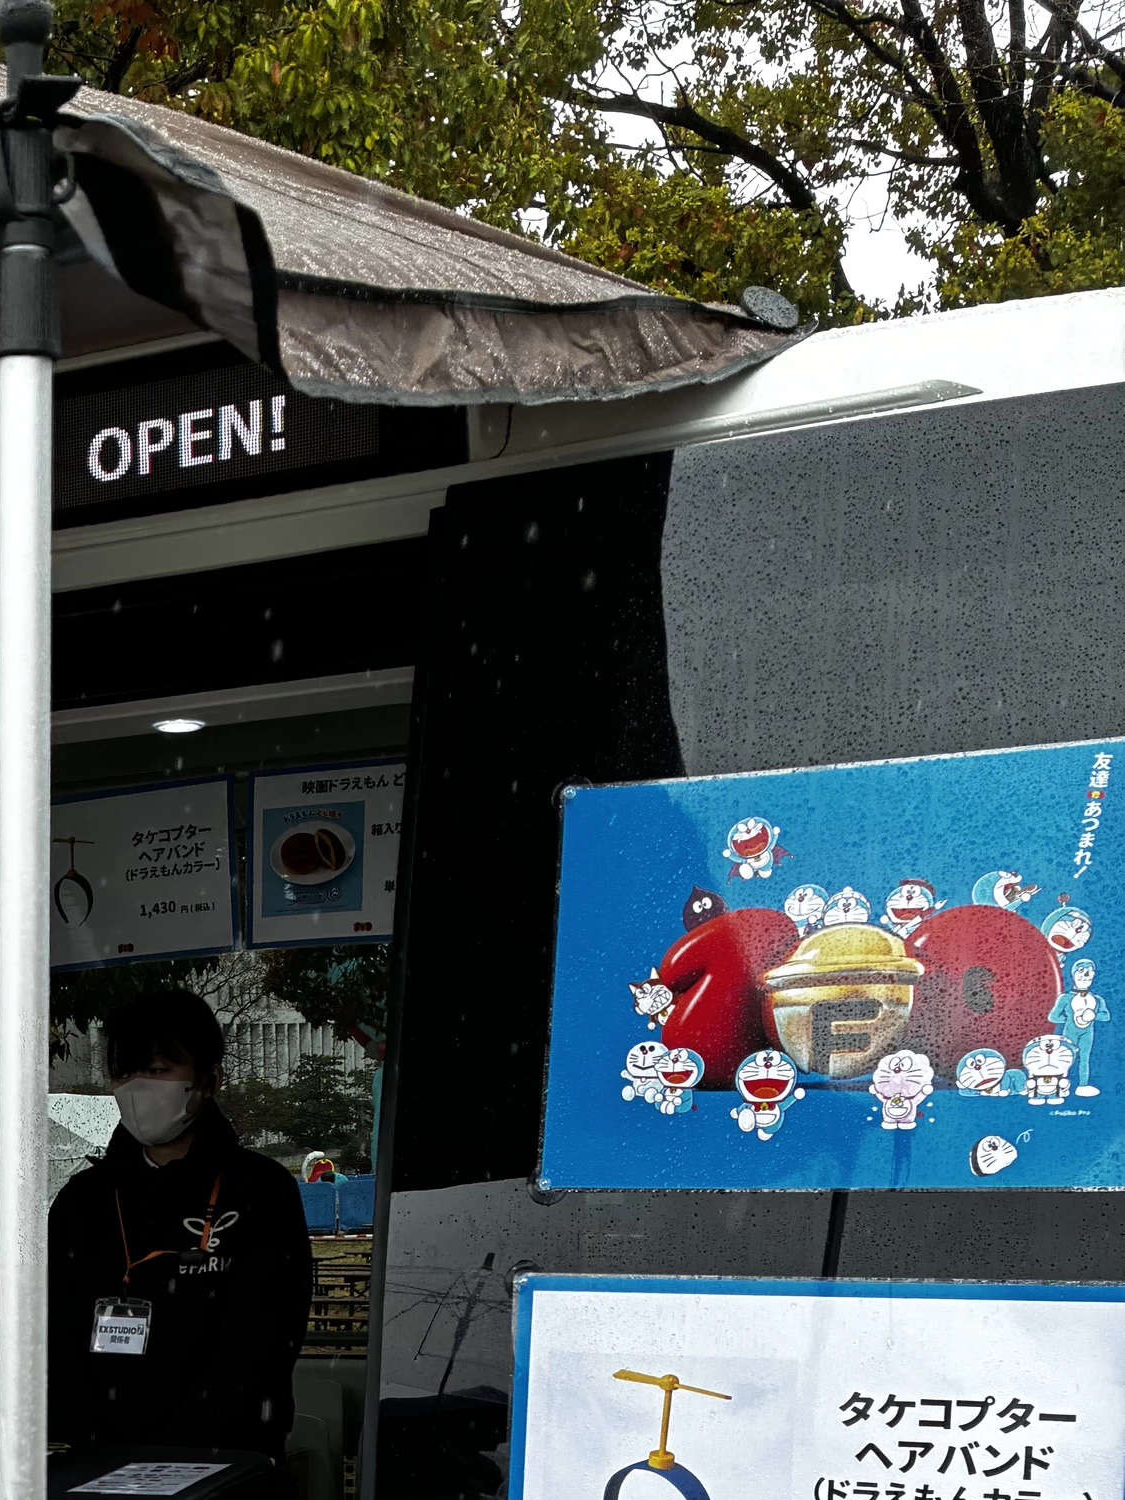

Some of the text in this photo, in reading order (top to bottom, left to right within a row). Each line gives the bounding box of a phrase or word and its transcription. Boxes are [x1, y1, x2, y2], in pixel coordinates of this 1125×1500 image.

[87, 395, 287, 482] OPEN!
[131, 823, 212, 848] タケコプター
[138, 841, 206, 862] ヘアバンド
[139, 900, 177, 919] 1,430
[838, 1391, 1078, 1435] タケコプター
[856, 1441, 1055, 1482] ヘアバンド
